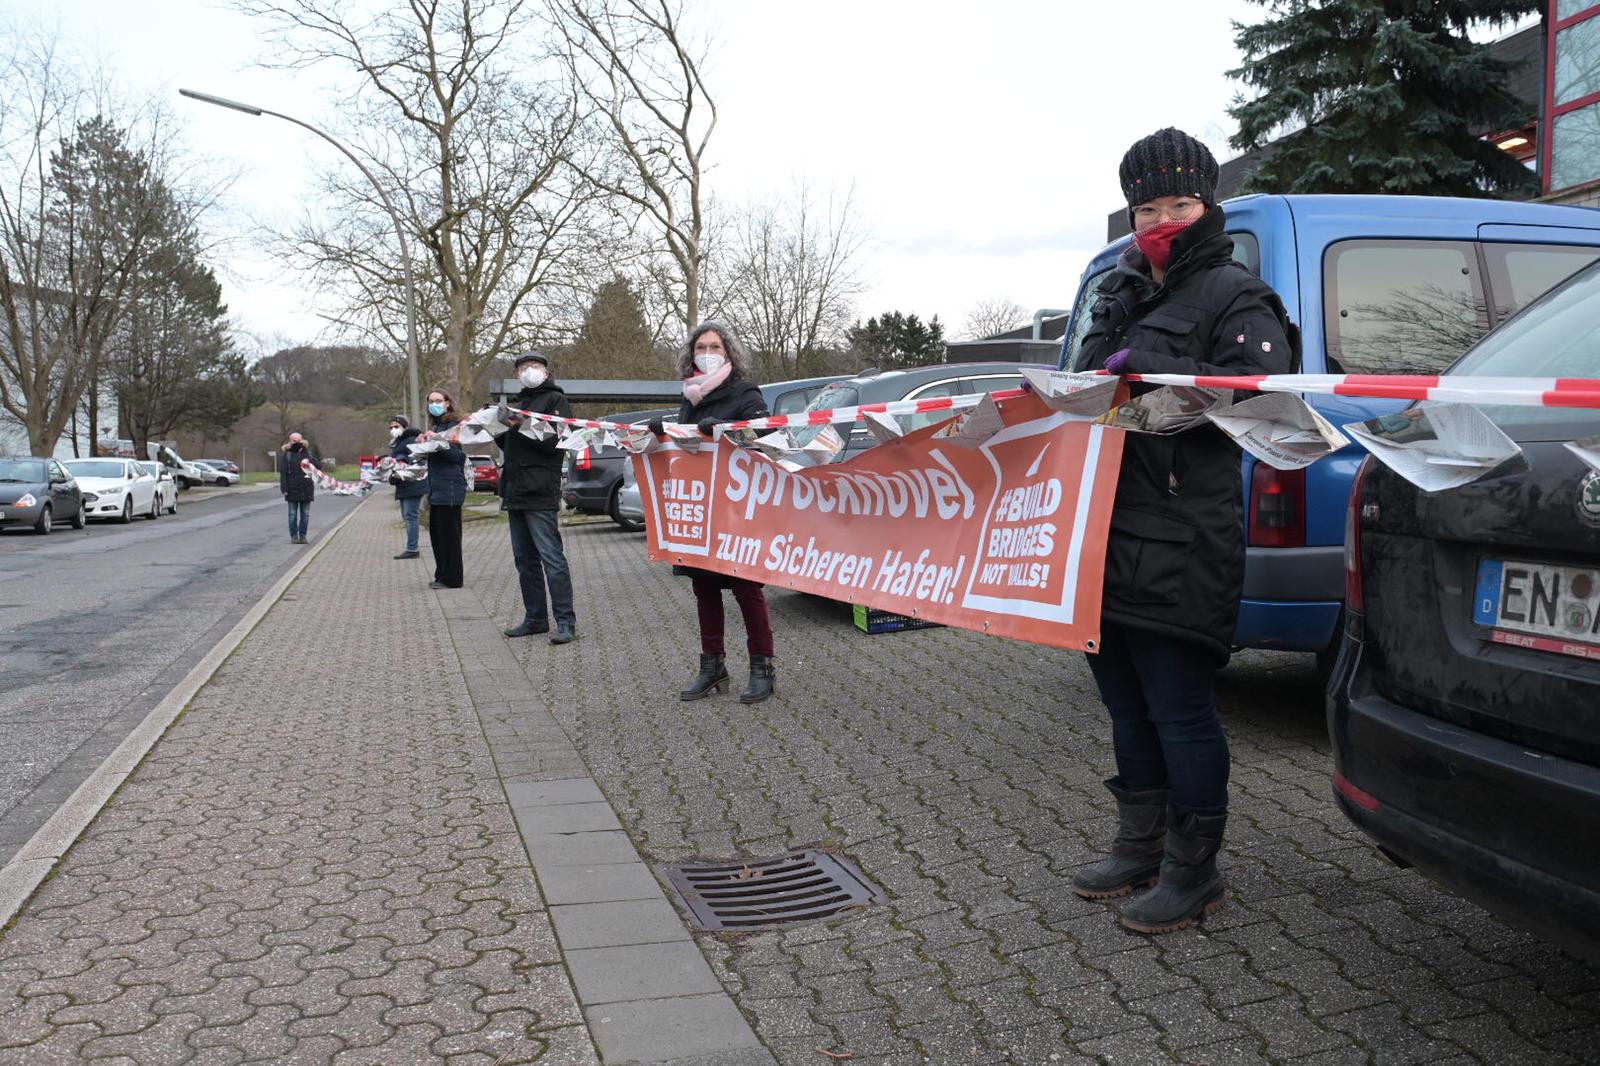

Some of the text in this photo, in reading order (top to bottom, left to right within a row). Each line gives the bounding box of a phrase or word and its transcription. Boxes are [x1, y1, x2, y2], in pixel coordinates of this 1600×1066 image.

[995, 478, 1063, 523] #BUILD
[987, 522, 1057, 558] BRIDGES
[715, 532, 966, 605] zum Sicheren Hafen!
[979, 562, 1009, 585] NOT
[1482, 598, 1493, 613] D
[1504, 633, 1538, 648] SEAT
